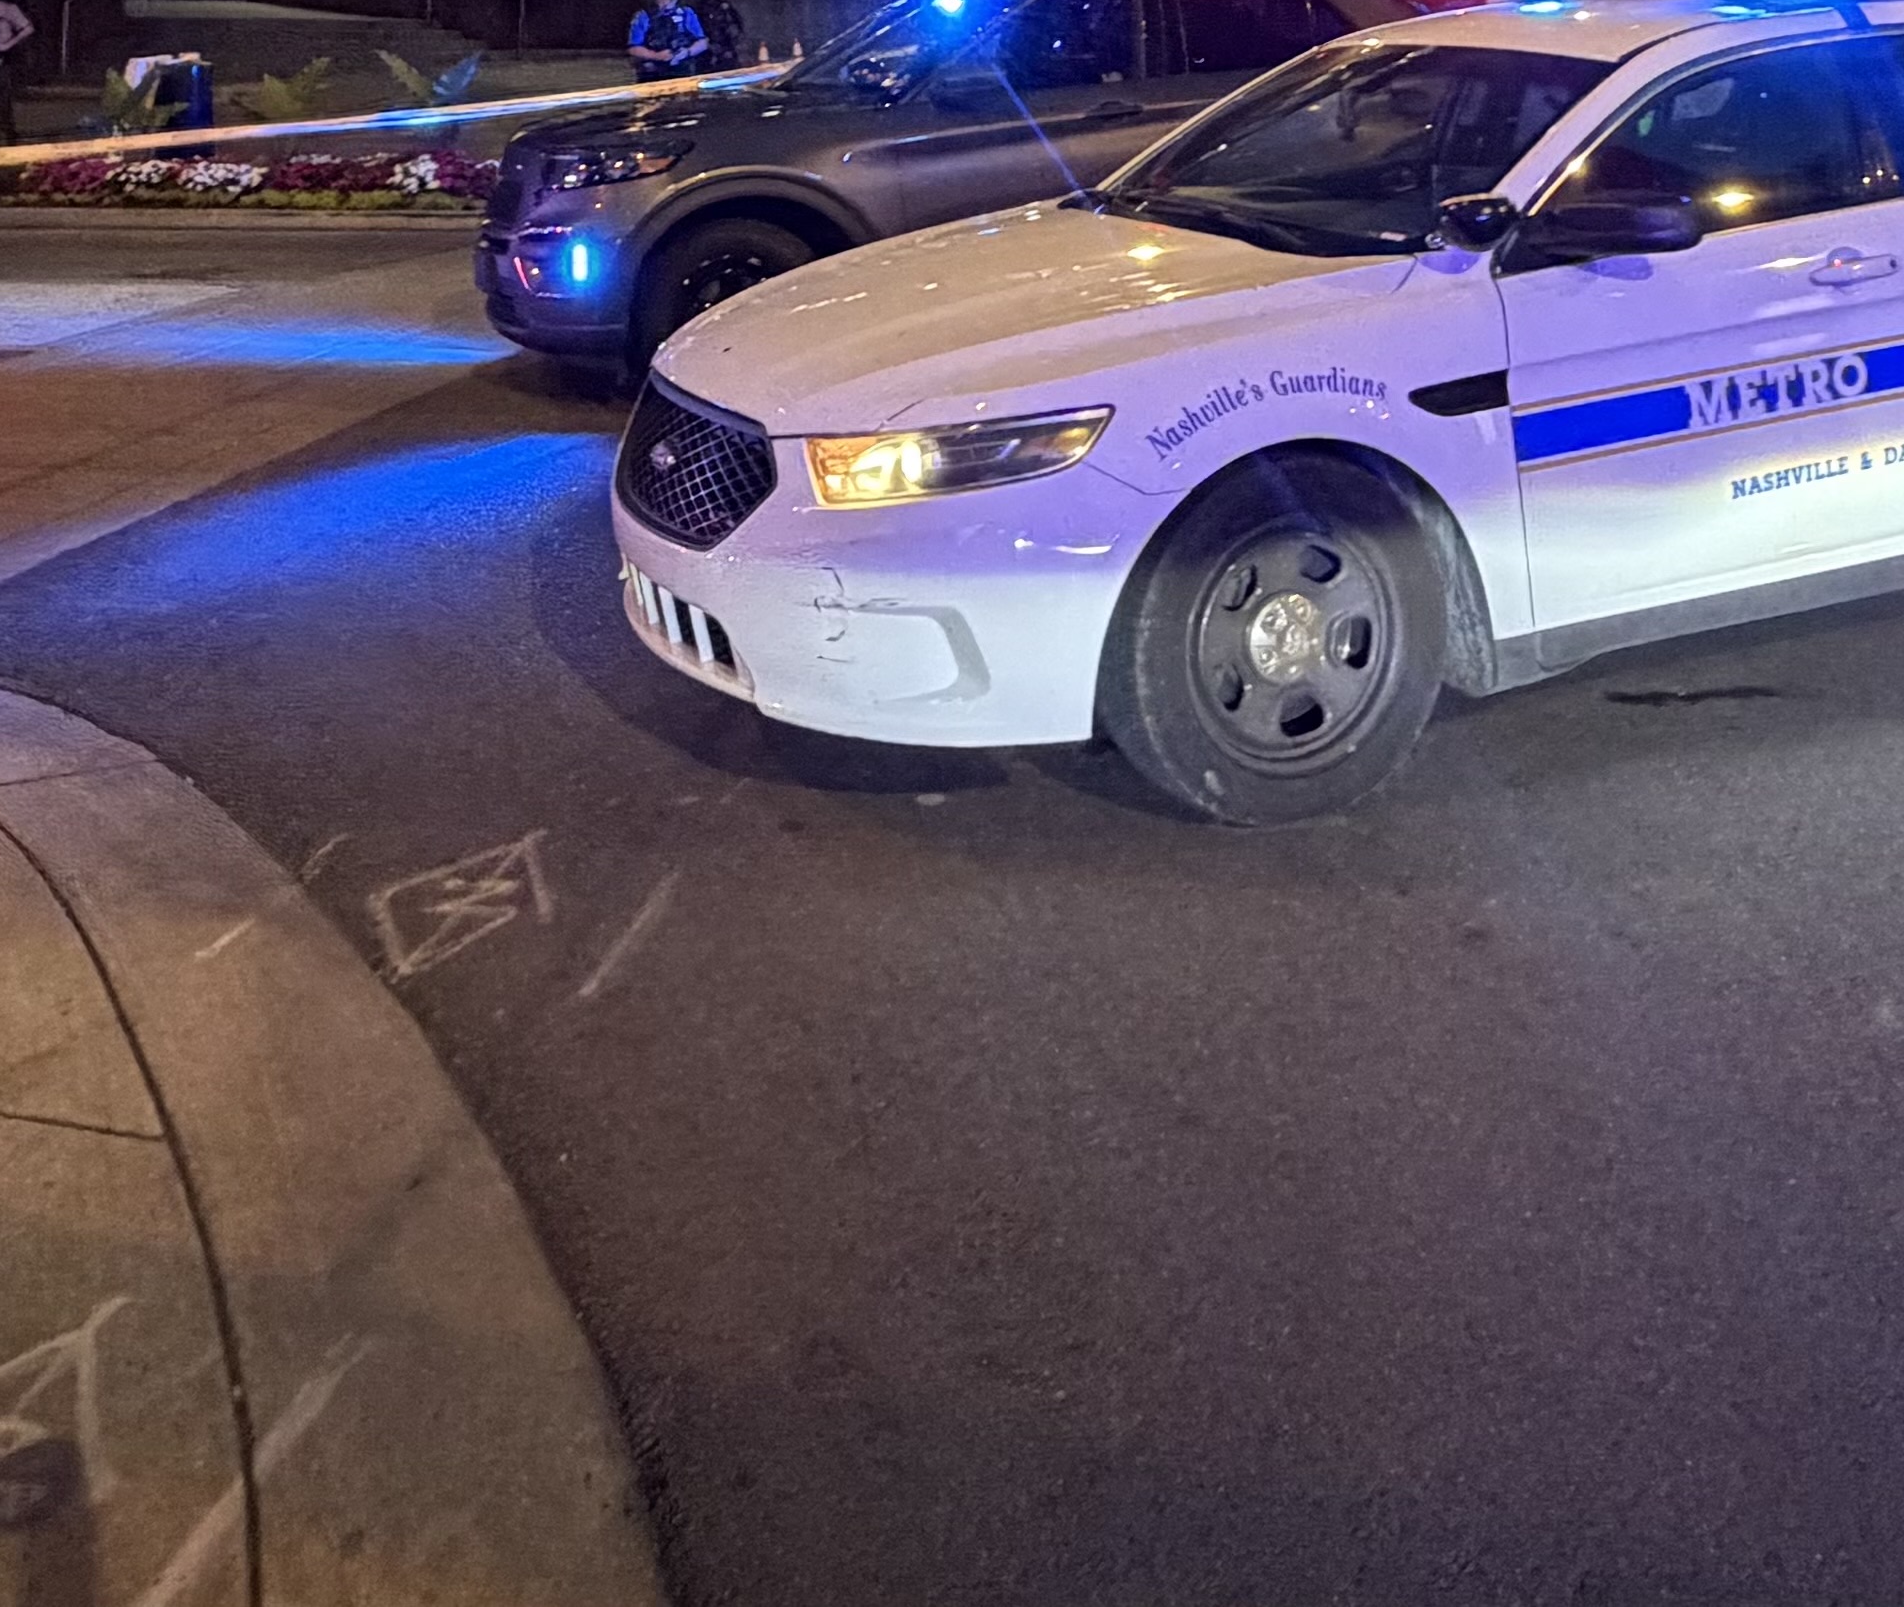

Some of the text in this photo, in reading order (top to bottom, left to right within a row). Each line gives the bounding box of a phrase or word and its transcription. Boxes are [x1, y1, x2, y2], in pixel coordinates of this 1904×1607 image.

[1143, 366, 1388, 462] Nashville's Guardians
[1684, 351, 1871, 430] METRO
[1731, 455, 1849, 500] NASHVILLE
[1860, 451, 1874, 471] &
